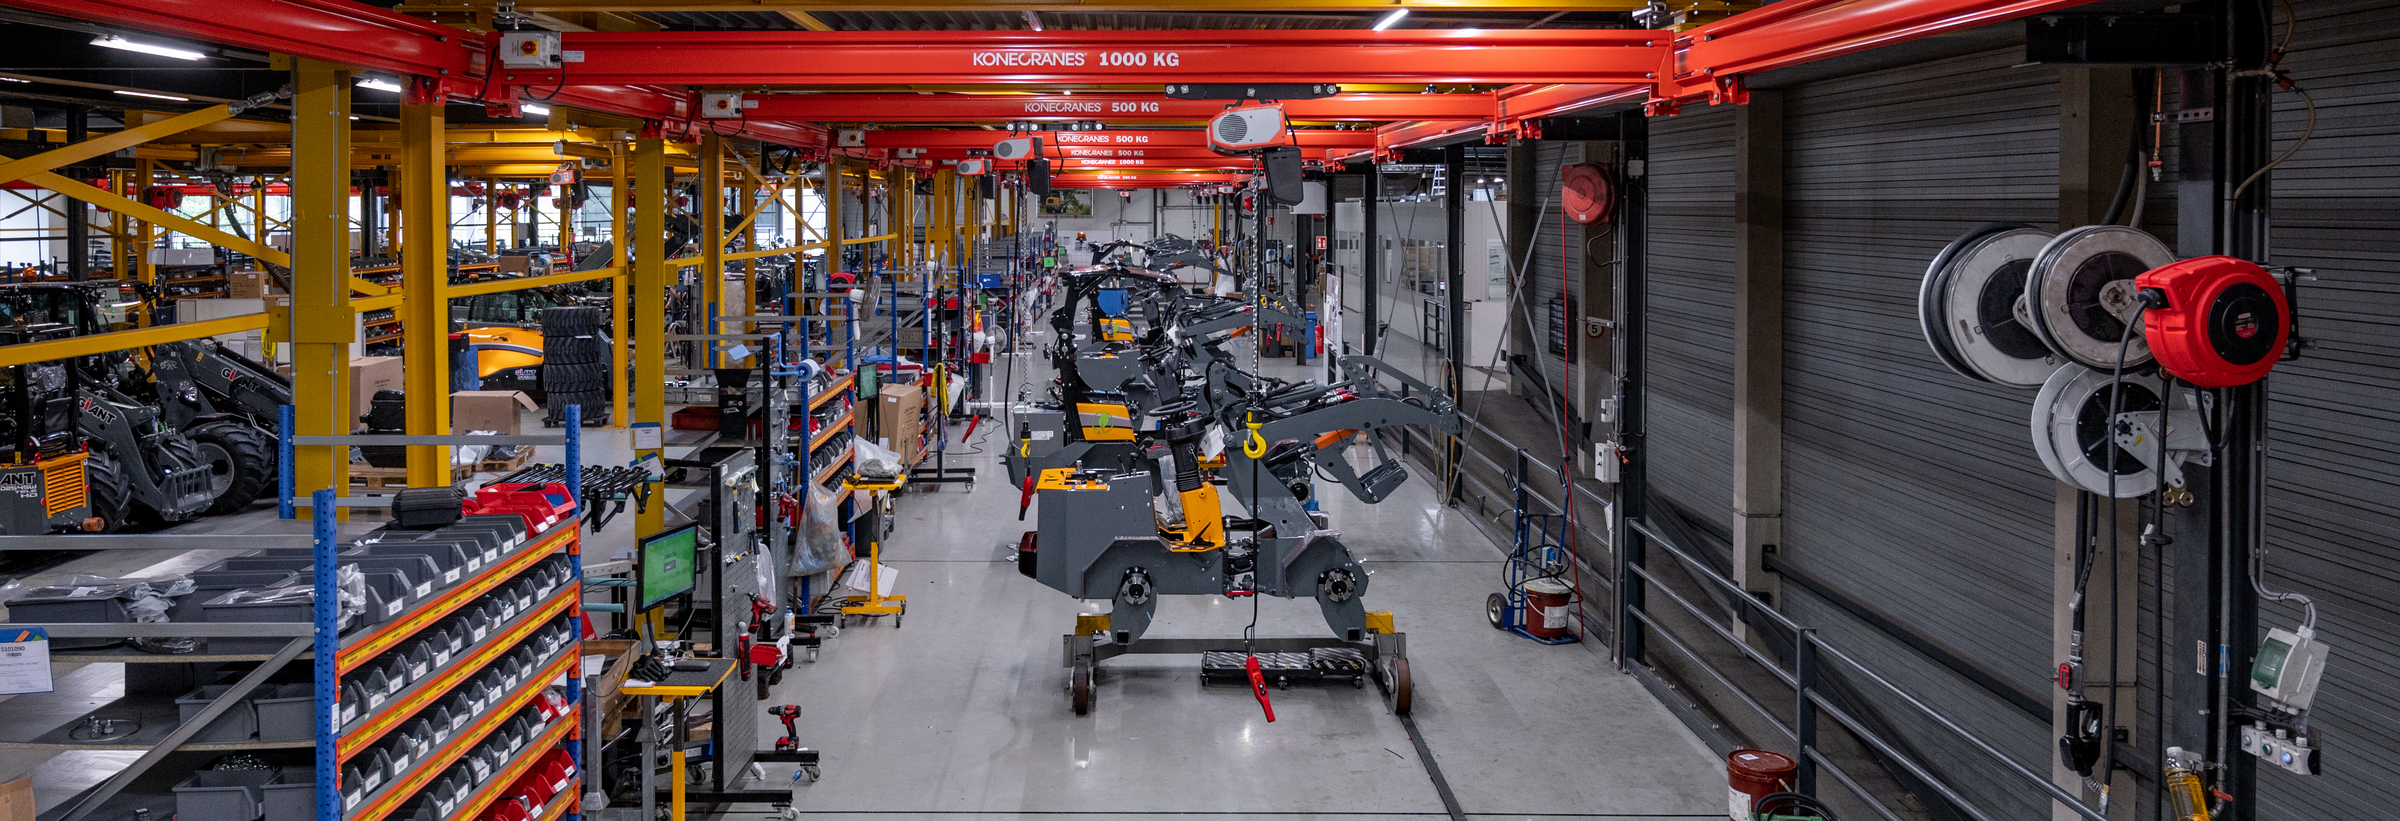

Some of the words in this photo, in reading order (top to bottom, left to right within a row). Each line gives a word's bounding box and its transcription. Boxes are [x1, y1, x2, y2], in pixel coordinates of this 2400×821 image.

[973, 52, 1085, 66] KONECRANES
[1100, 52, 1147, 66] 1000
[1153, 52, 1179, 66] KG
[1025, 102, 1101, 112] KONECRANES
[1112, 102, 1136, 112] 500
[1141, 102, 1159, 112] KG
[1057, 135, 1109, 143] KONECRANES
[1116, 135, 1133, 143] 500
[1136, 135, 1148, 143] KG
[1592, 325, 1598, 333] 5
